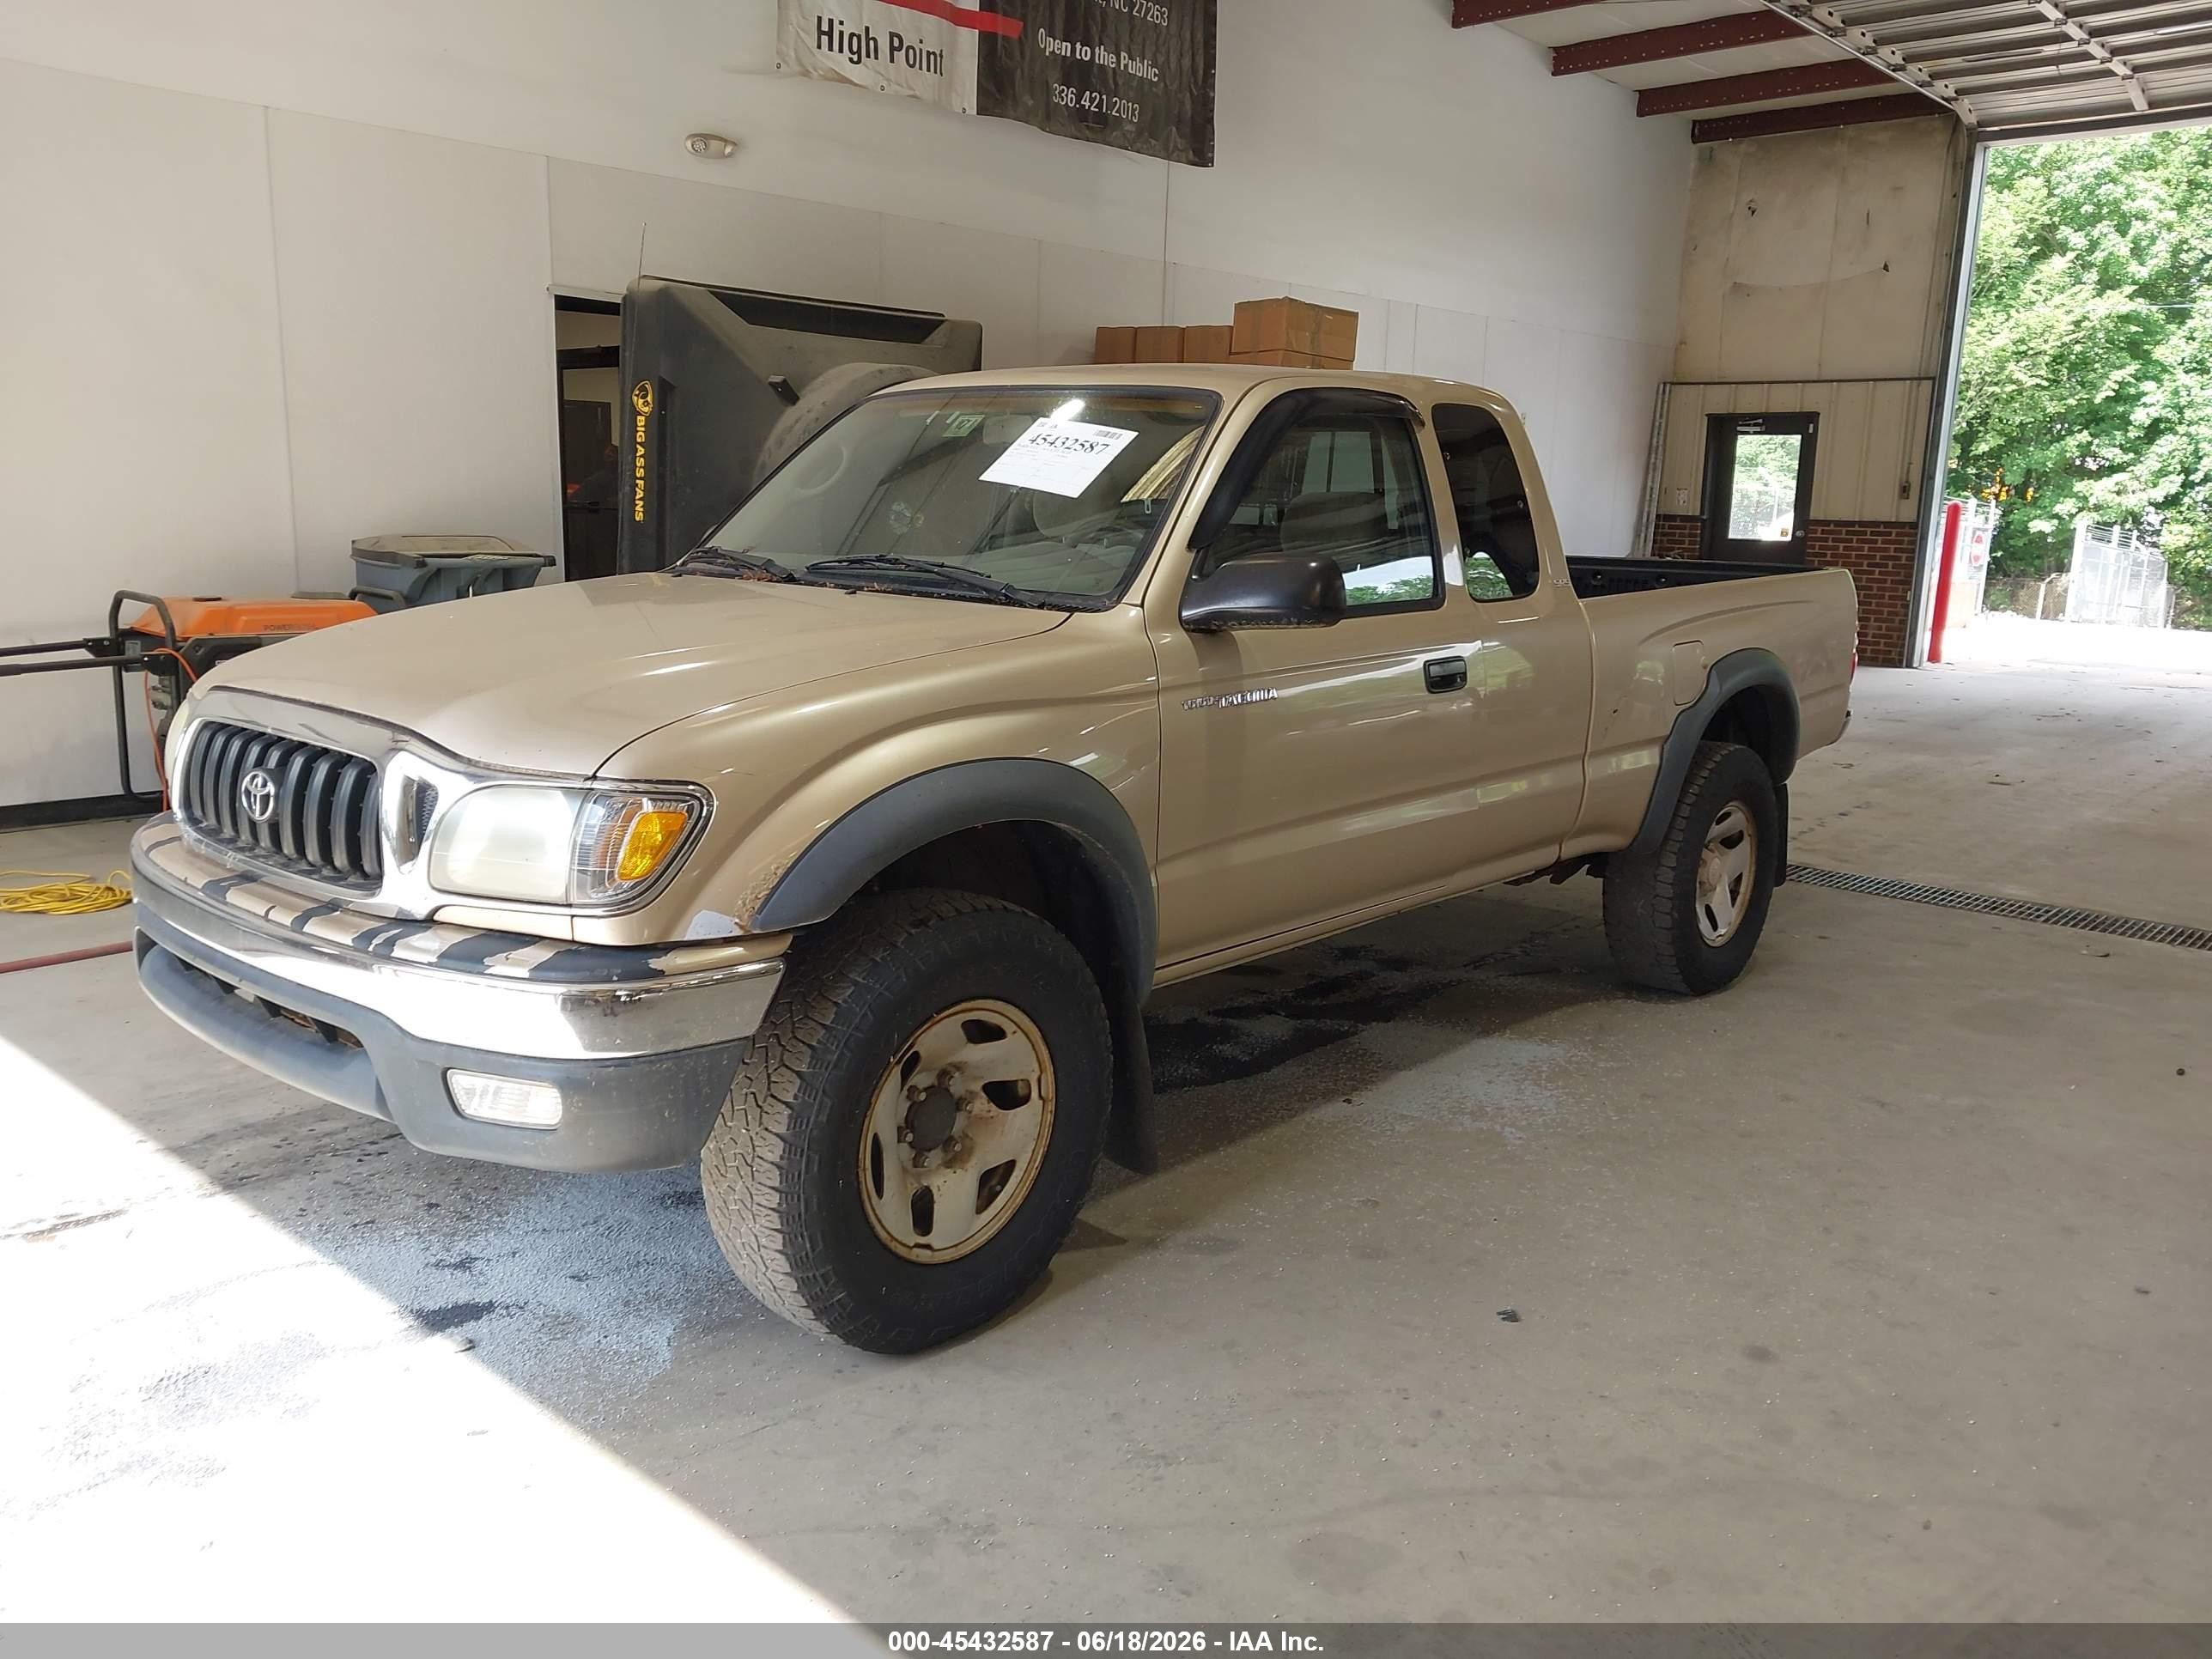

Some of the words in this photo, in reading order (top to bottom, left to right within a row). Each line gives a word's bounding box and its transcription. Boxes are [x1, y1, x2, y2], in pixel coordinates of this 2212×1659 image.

[1133, 0, 1169, 26] 27263
[817, 15, 879, 65] High
[888, 31, 944, 76] Point
[1038, 27, 1072, 57] Open
[1075, 41, 1091, 61] to
[1095, 45, 1116, 68] the
[1120, 51, 1159, 82] Public
[1052, 83, 1139, 122] 336.421.2013
[636, 416, 646, 442] BIG
[1028, 432, 1111, 455] 45432587
[635, 444, 645, 477] ASS
[635, 480, 644, 522] FANS
